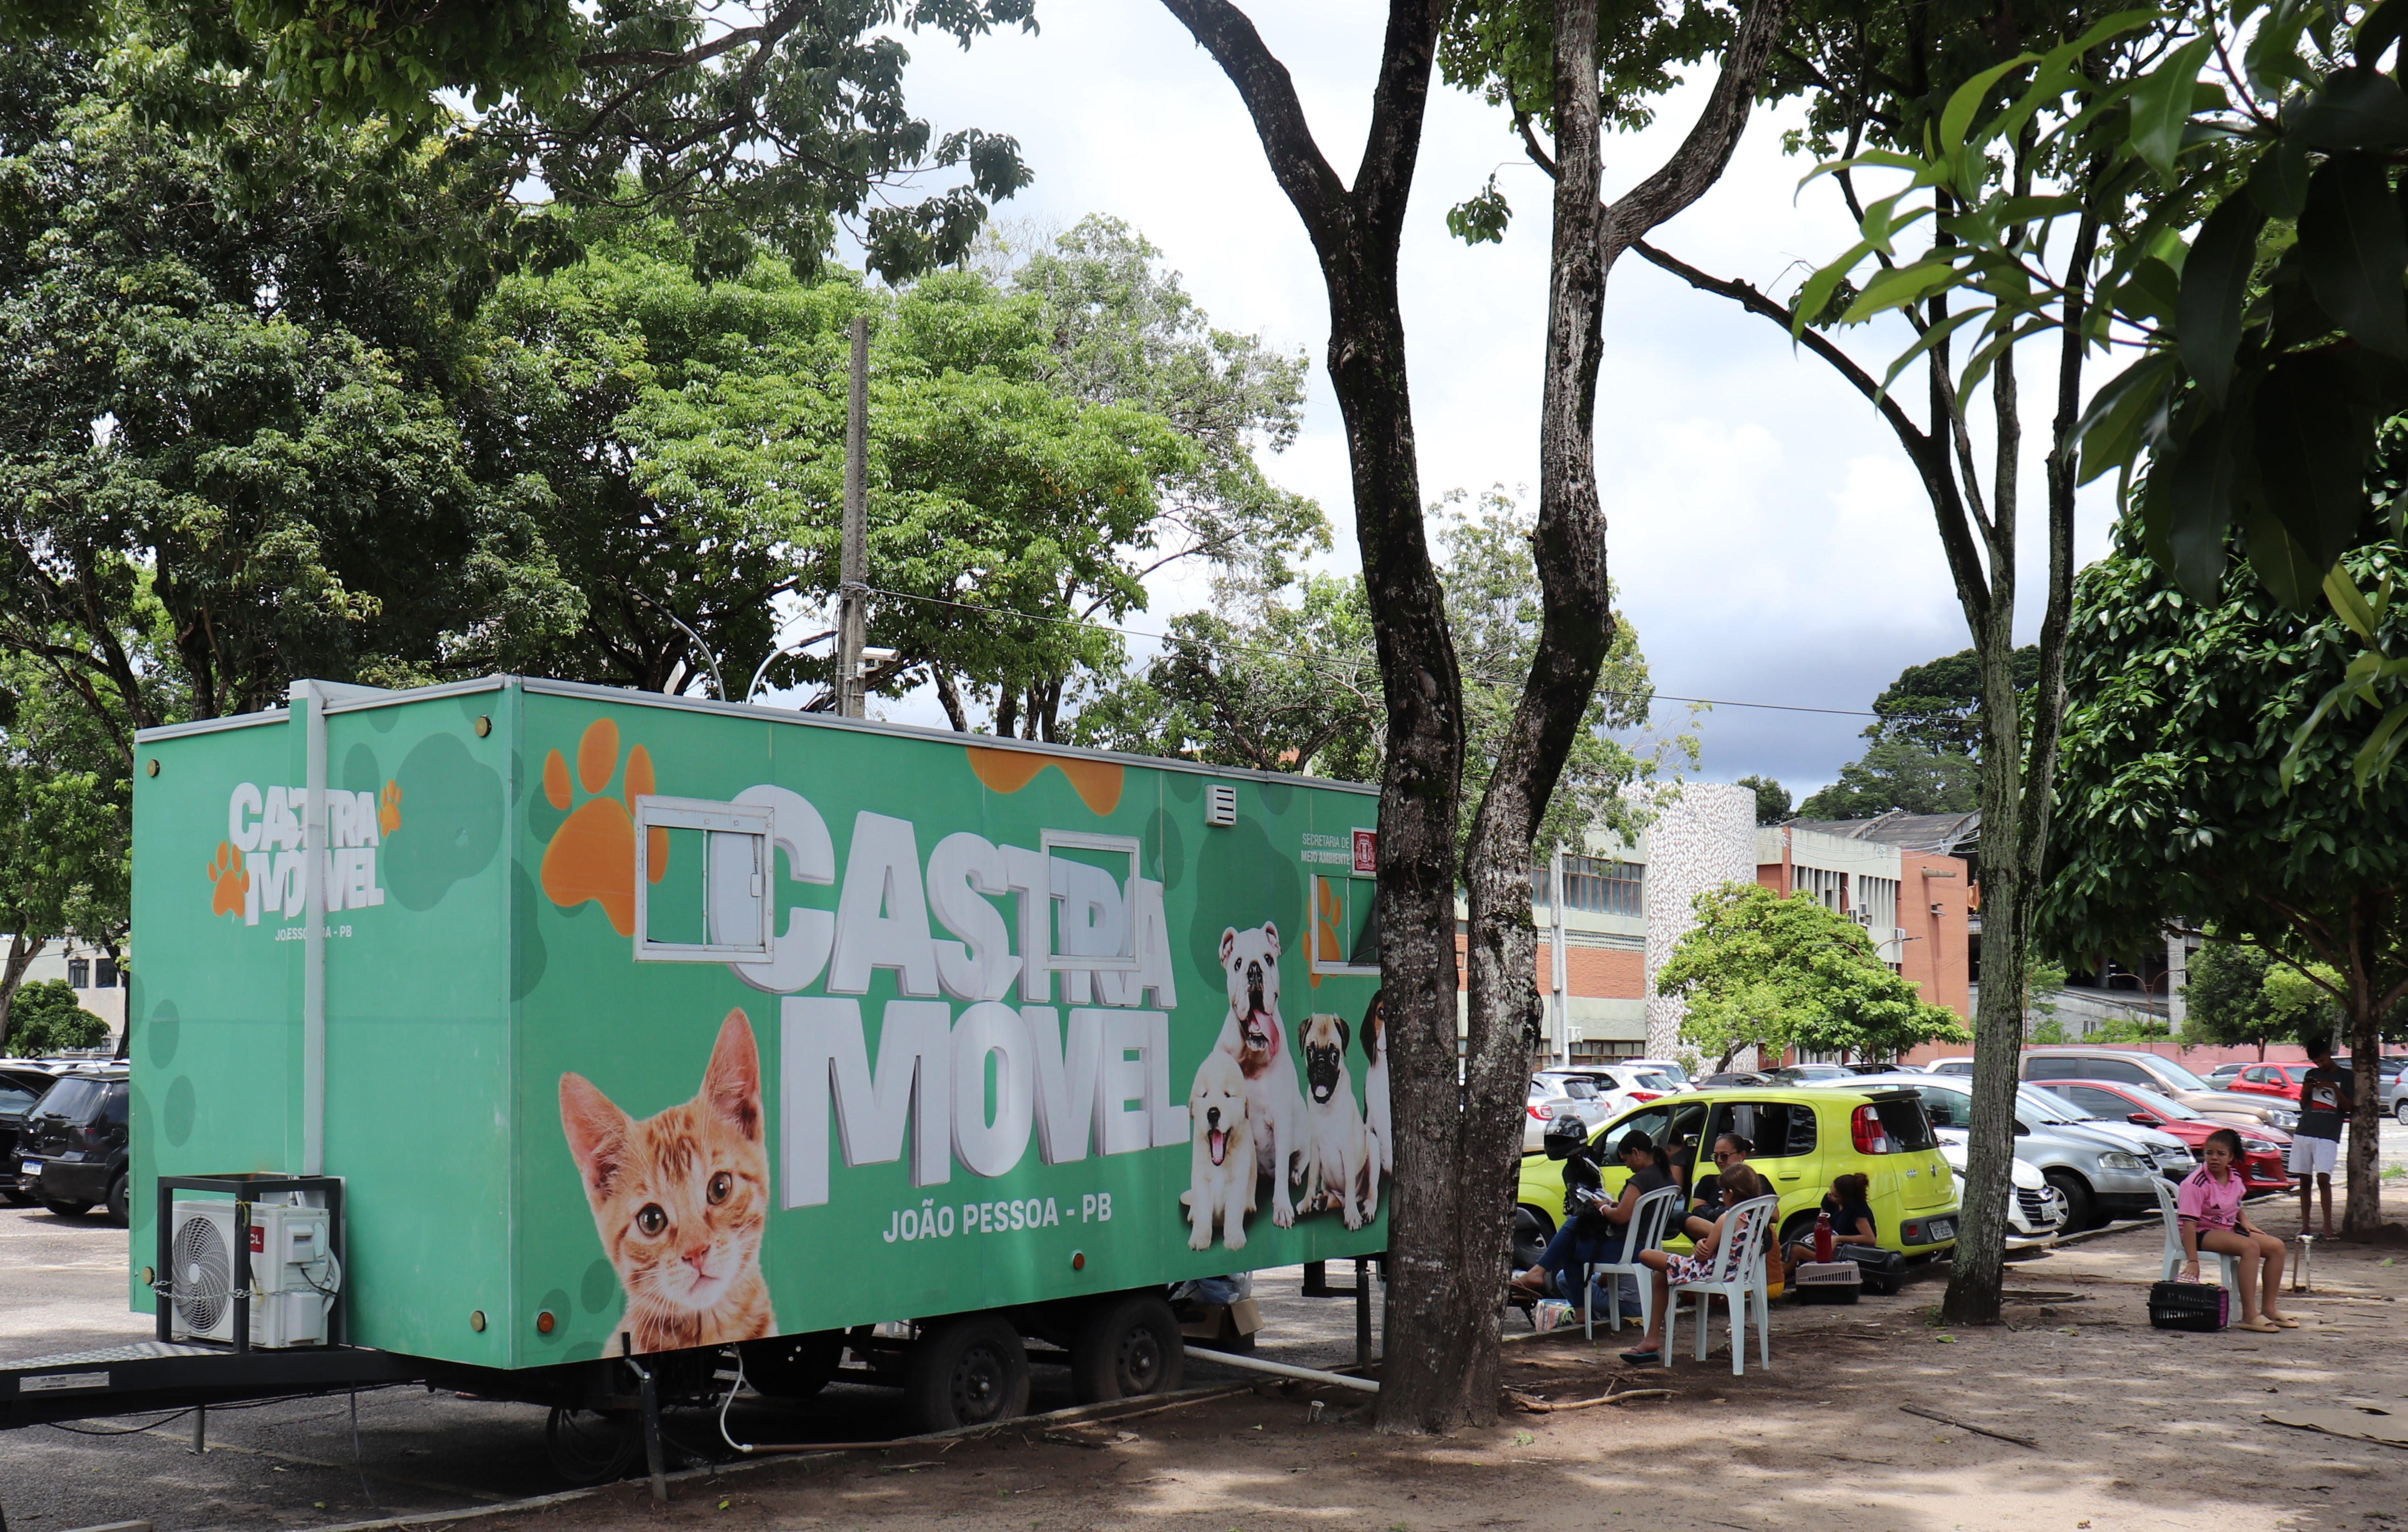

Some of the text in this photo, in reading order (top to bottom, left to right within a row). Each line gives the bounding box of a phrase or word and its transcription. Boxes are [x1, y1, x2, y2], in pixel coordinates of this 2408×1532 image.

[1302, 833, 1350, 848] SECRETARIA DE
[1301, 850, 1351, 865] MEIO AMBIENTE
[709, 784, 1177, 1009] CASTRA
[340, 925, 352, 938] PB
[883, 1198, 954, 1244] JOÃO
[963, 1197, 1059, 1235] PESSOA
[1082, 1192, 1112, 1224] PB
